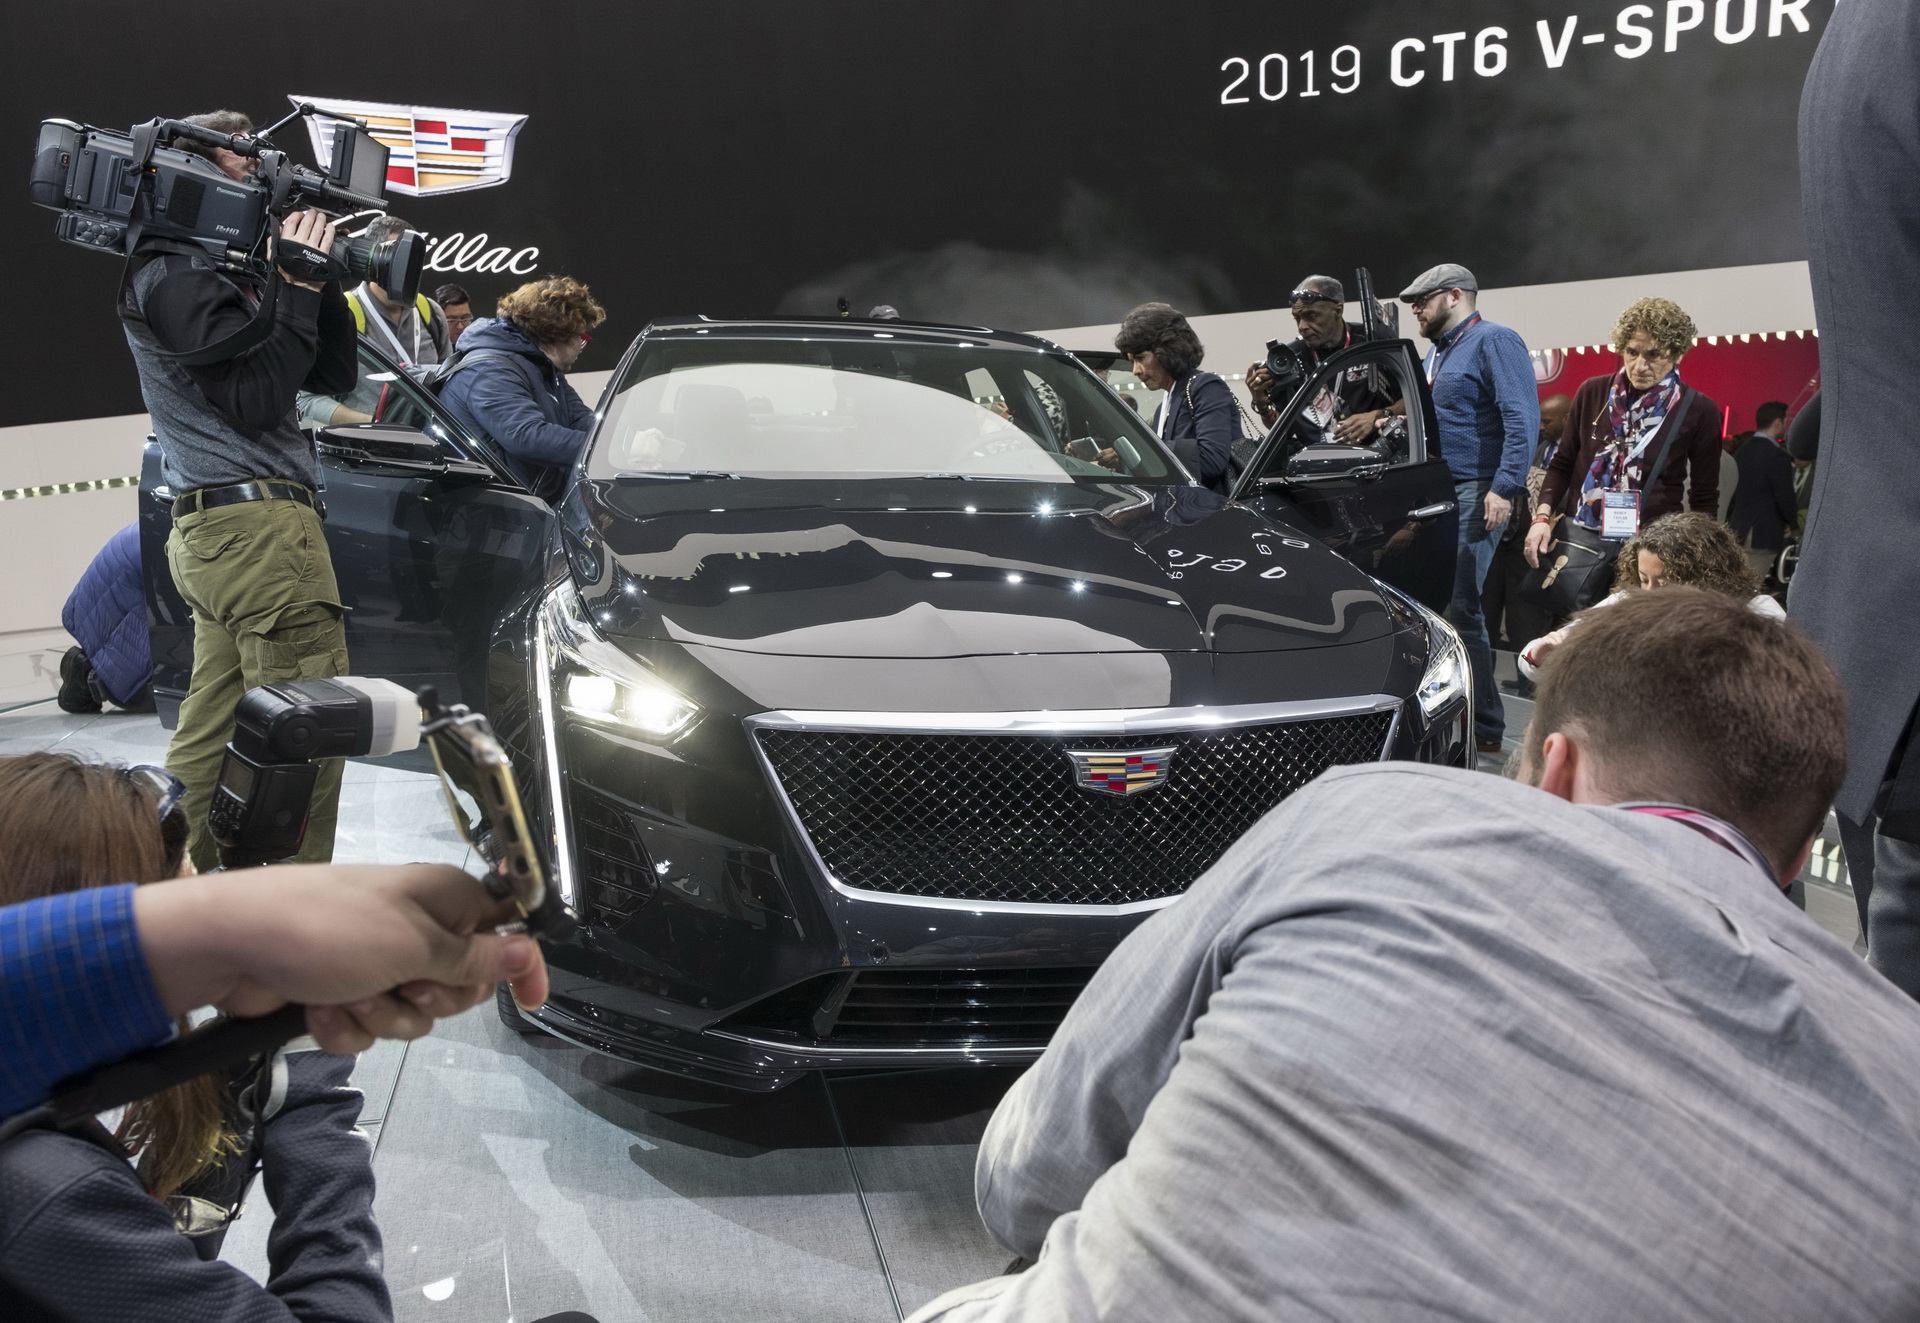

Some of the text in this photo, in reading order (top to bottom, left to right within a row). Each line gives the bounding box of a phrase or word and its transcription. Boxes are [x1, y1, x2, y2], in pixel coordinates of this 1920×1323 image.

[1220, 0, 1838, 105] 2019 CT6 V-SPOR
[216, 186, 247, 199] Panasonic
[302, 249, 328, 264] FUJINON
